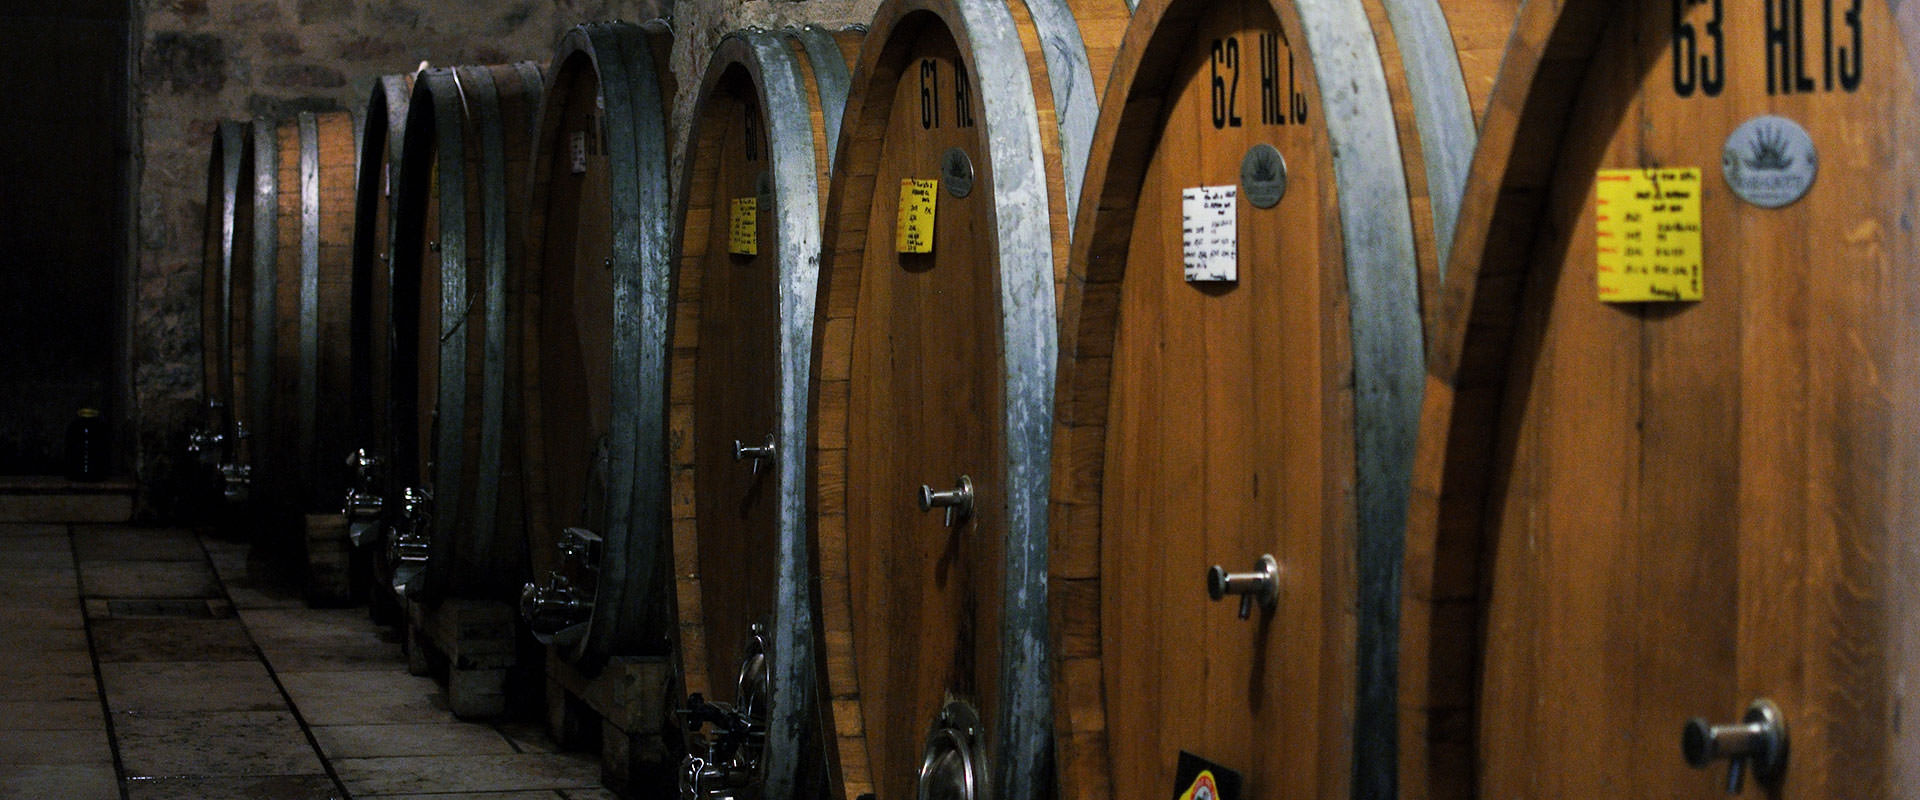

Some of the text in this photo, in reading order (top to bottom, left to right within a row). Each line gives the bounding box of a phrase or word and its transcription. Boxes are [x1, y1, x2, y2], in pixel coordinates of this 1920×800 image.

[920, 58, 939, 130] 61
[1211, 36, 1242, 130] 62
[1672, 0, 1724, 97] 63
